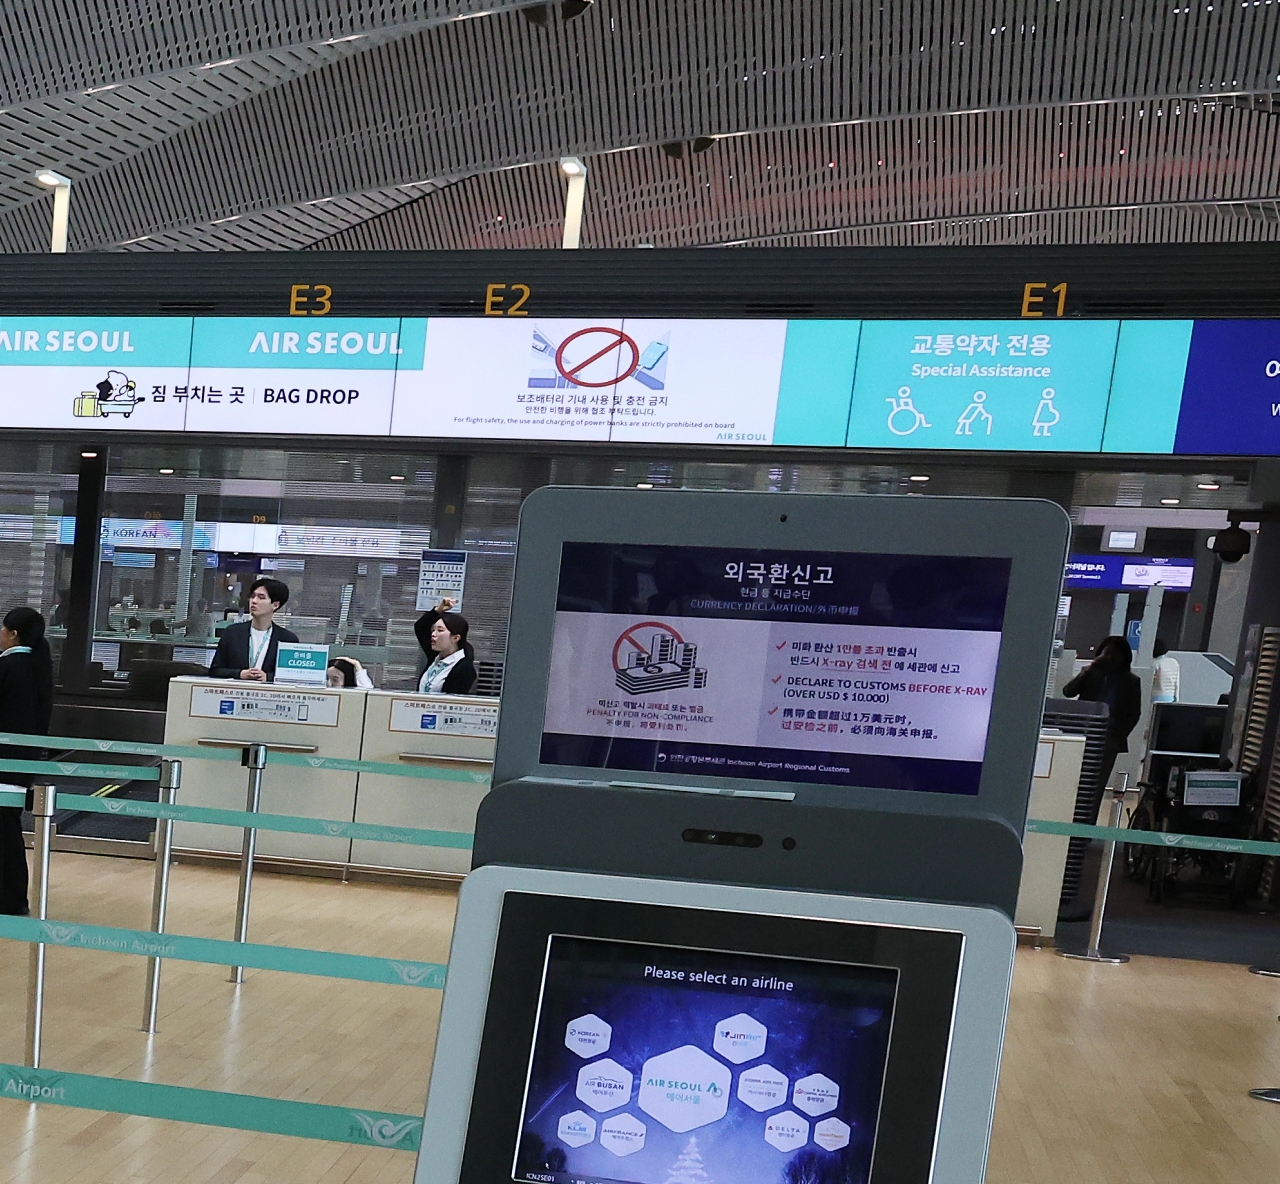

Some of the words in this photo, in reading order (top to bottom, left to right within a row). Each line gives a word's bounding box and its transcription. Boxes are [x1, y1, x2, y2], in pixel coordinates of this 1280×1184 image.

[289, 284, 333, 315] E3
[485, 284, 532, 315] E2
[1020, 282, 1068, 317] E1
[45, 330, 135, 352] SEOUL
[248, 331, 299, 354] AIR
[305, 331, 404, 355] SEOUL
[910, 334, 1000, 356] 교통약자
[1006, 334, 1052, 357] 전용
[911, 363, 966, 379] Special
[969, 364, 1051, 378] Assistance
[151, 386, 168, 403] 짐
[172, 386, 224, 404] 부치는
[229, 386, 246, 404] 곳
[263, 388, 301, 403] BAG
[306, 389, 360, 405] DROP
[516, 394, 564, 404] 보조배터리
[568, 395, 586, 404] 기내
[590, 395, 609, 405] 사용
[626, 396, 645, 406] 충전
[649, 396, 668, 406] 금지
[525, 406, 547, 414] 안전한
[549, 406, 571, 414] 비행을
[574, 406, 589, 415] 위해
[591, 407, 606, 415] 협조
[484, 417, 506, 425] safety,
[546, 418, 575, 426] charging
[584, 419, 607, 427] power
[641, 420, 665, 428] strictly
[666, 421, 703, 429] prohibited
[735, 433, 767, 441] SEOUL
[724, 562, 834, 585] 외국환신고
[792, 641, 811, 652] 미화
[814, 642, 833, 653] 환산
[288, 659, 315, 667] CLOSED
[790, 656, 820, 667] 반드시
[822, 658, 853, 669] X-ray
[856, 659, 878, 670] 검색
[940, 663, 960, 674] 신고
[783, 688, 815, 699] (OVER
[818, 691, 840, 700] USD
[842, 691, 849, 701] $
[787, 676, 834, 688] DECLARE
[838, 679, 852, 689] TO
[854, 680, 906, 692] CUSTOMS
[908, 683, 952, 694] BEFORE
[953, 685, 988, 696] X-RAY
[644, 965, 685, 981] Please
[689, 971, 727, 985] select
[731, 977, 747, 987] an
[752, 975, 794, 992] airline
[4, 1079, 66, 1100] Airport
[597, 1081, 624, 1091] BUSAN
[646, 1079, 665, 1088] AIR
[667, 1080, 702, 1092] SEOUL
